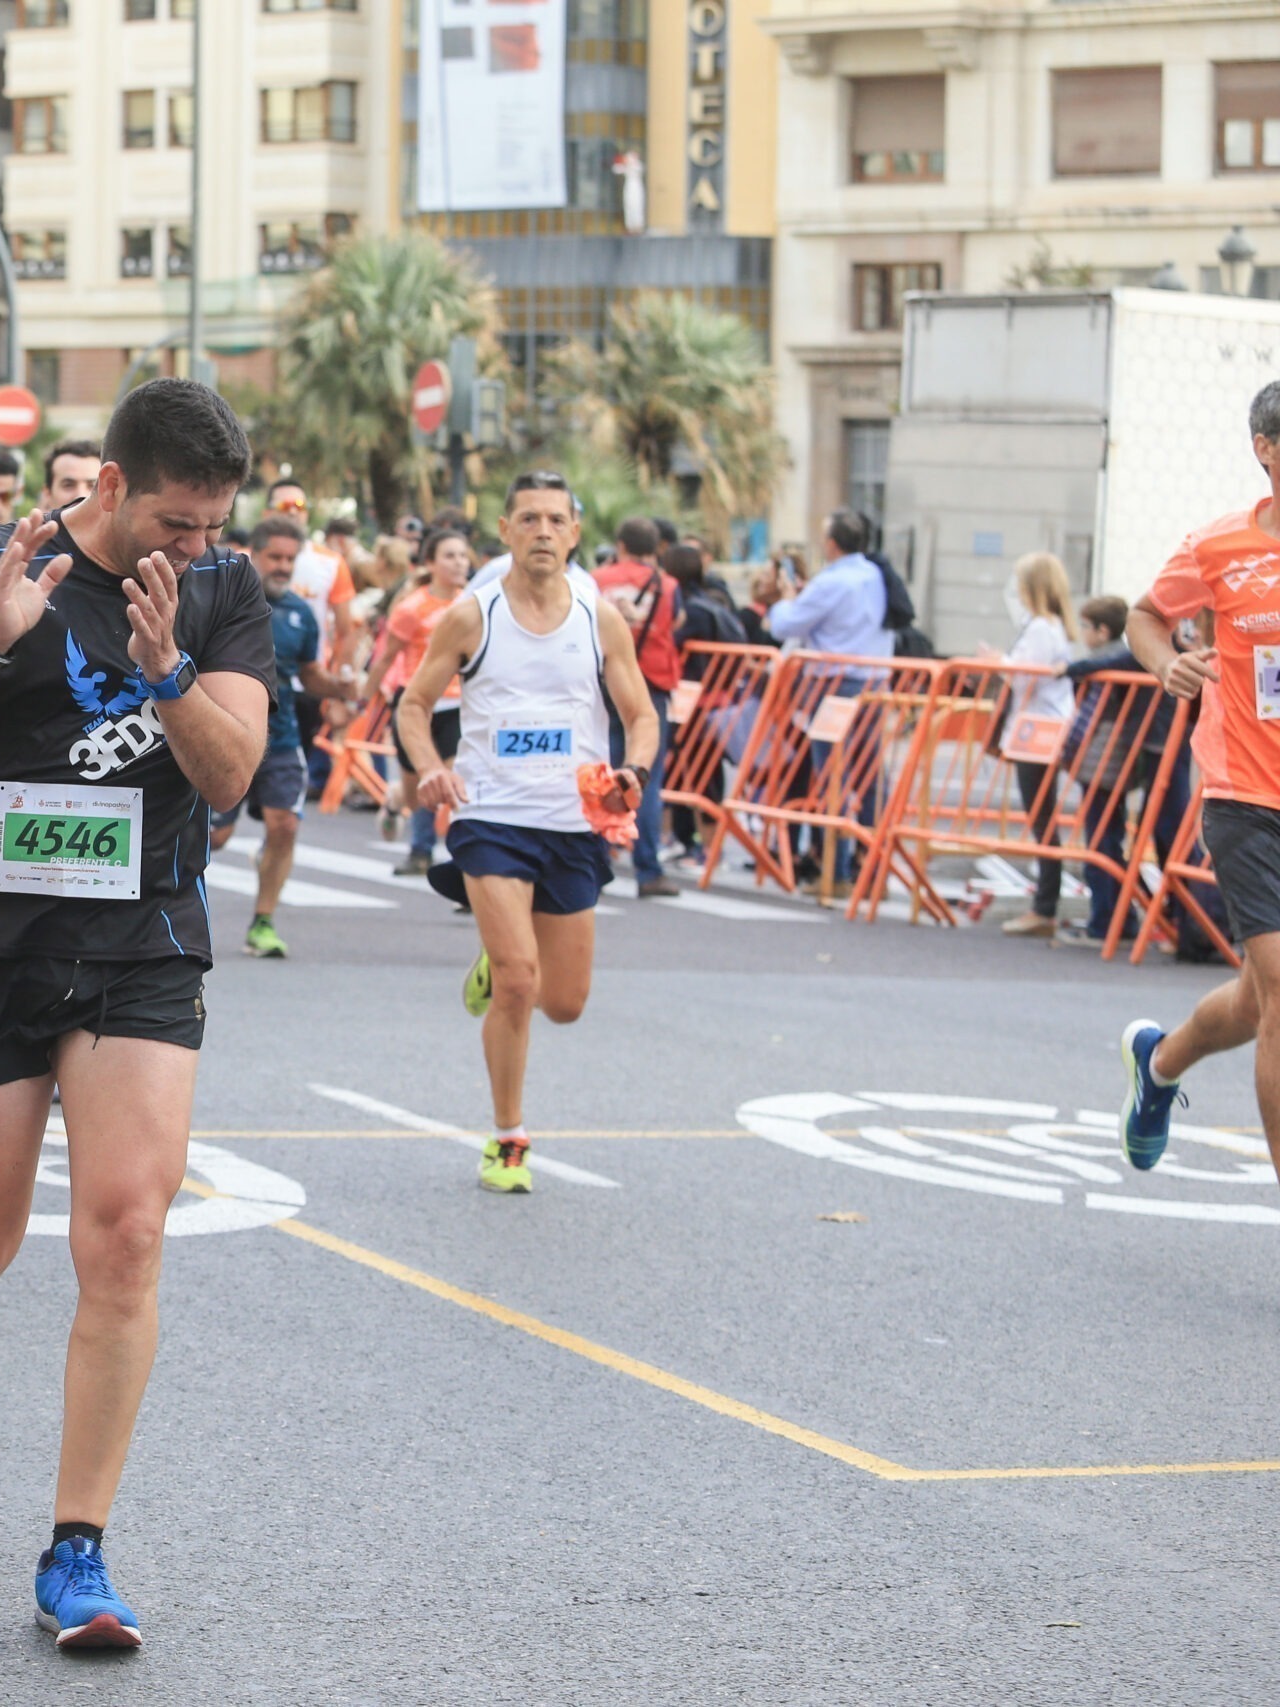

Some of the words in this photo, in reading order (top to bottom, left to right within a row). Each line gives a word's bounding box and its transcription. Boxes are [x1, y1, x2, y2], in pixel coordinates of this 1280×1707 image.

[82, 715, 106, 736] TEAM
[504, 732, 563, 754] 2541
[15, 819, 119, 858] 4546
[50, 857, 111, 867] PREFERENTE
